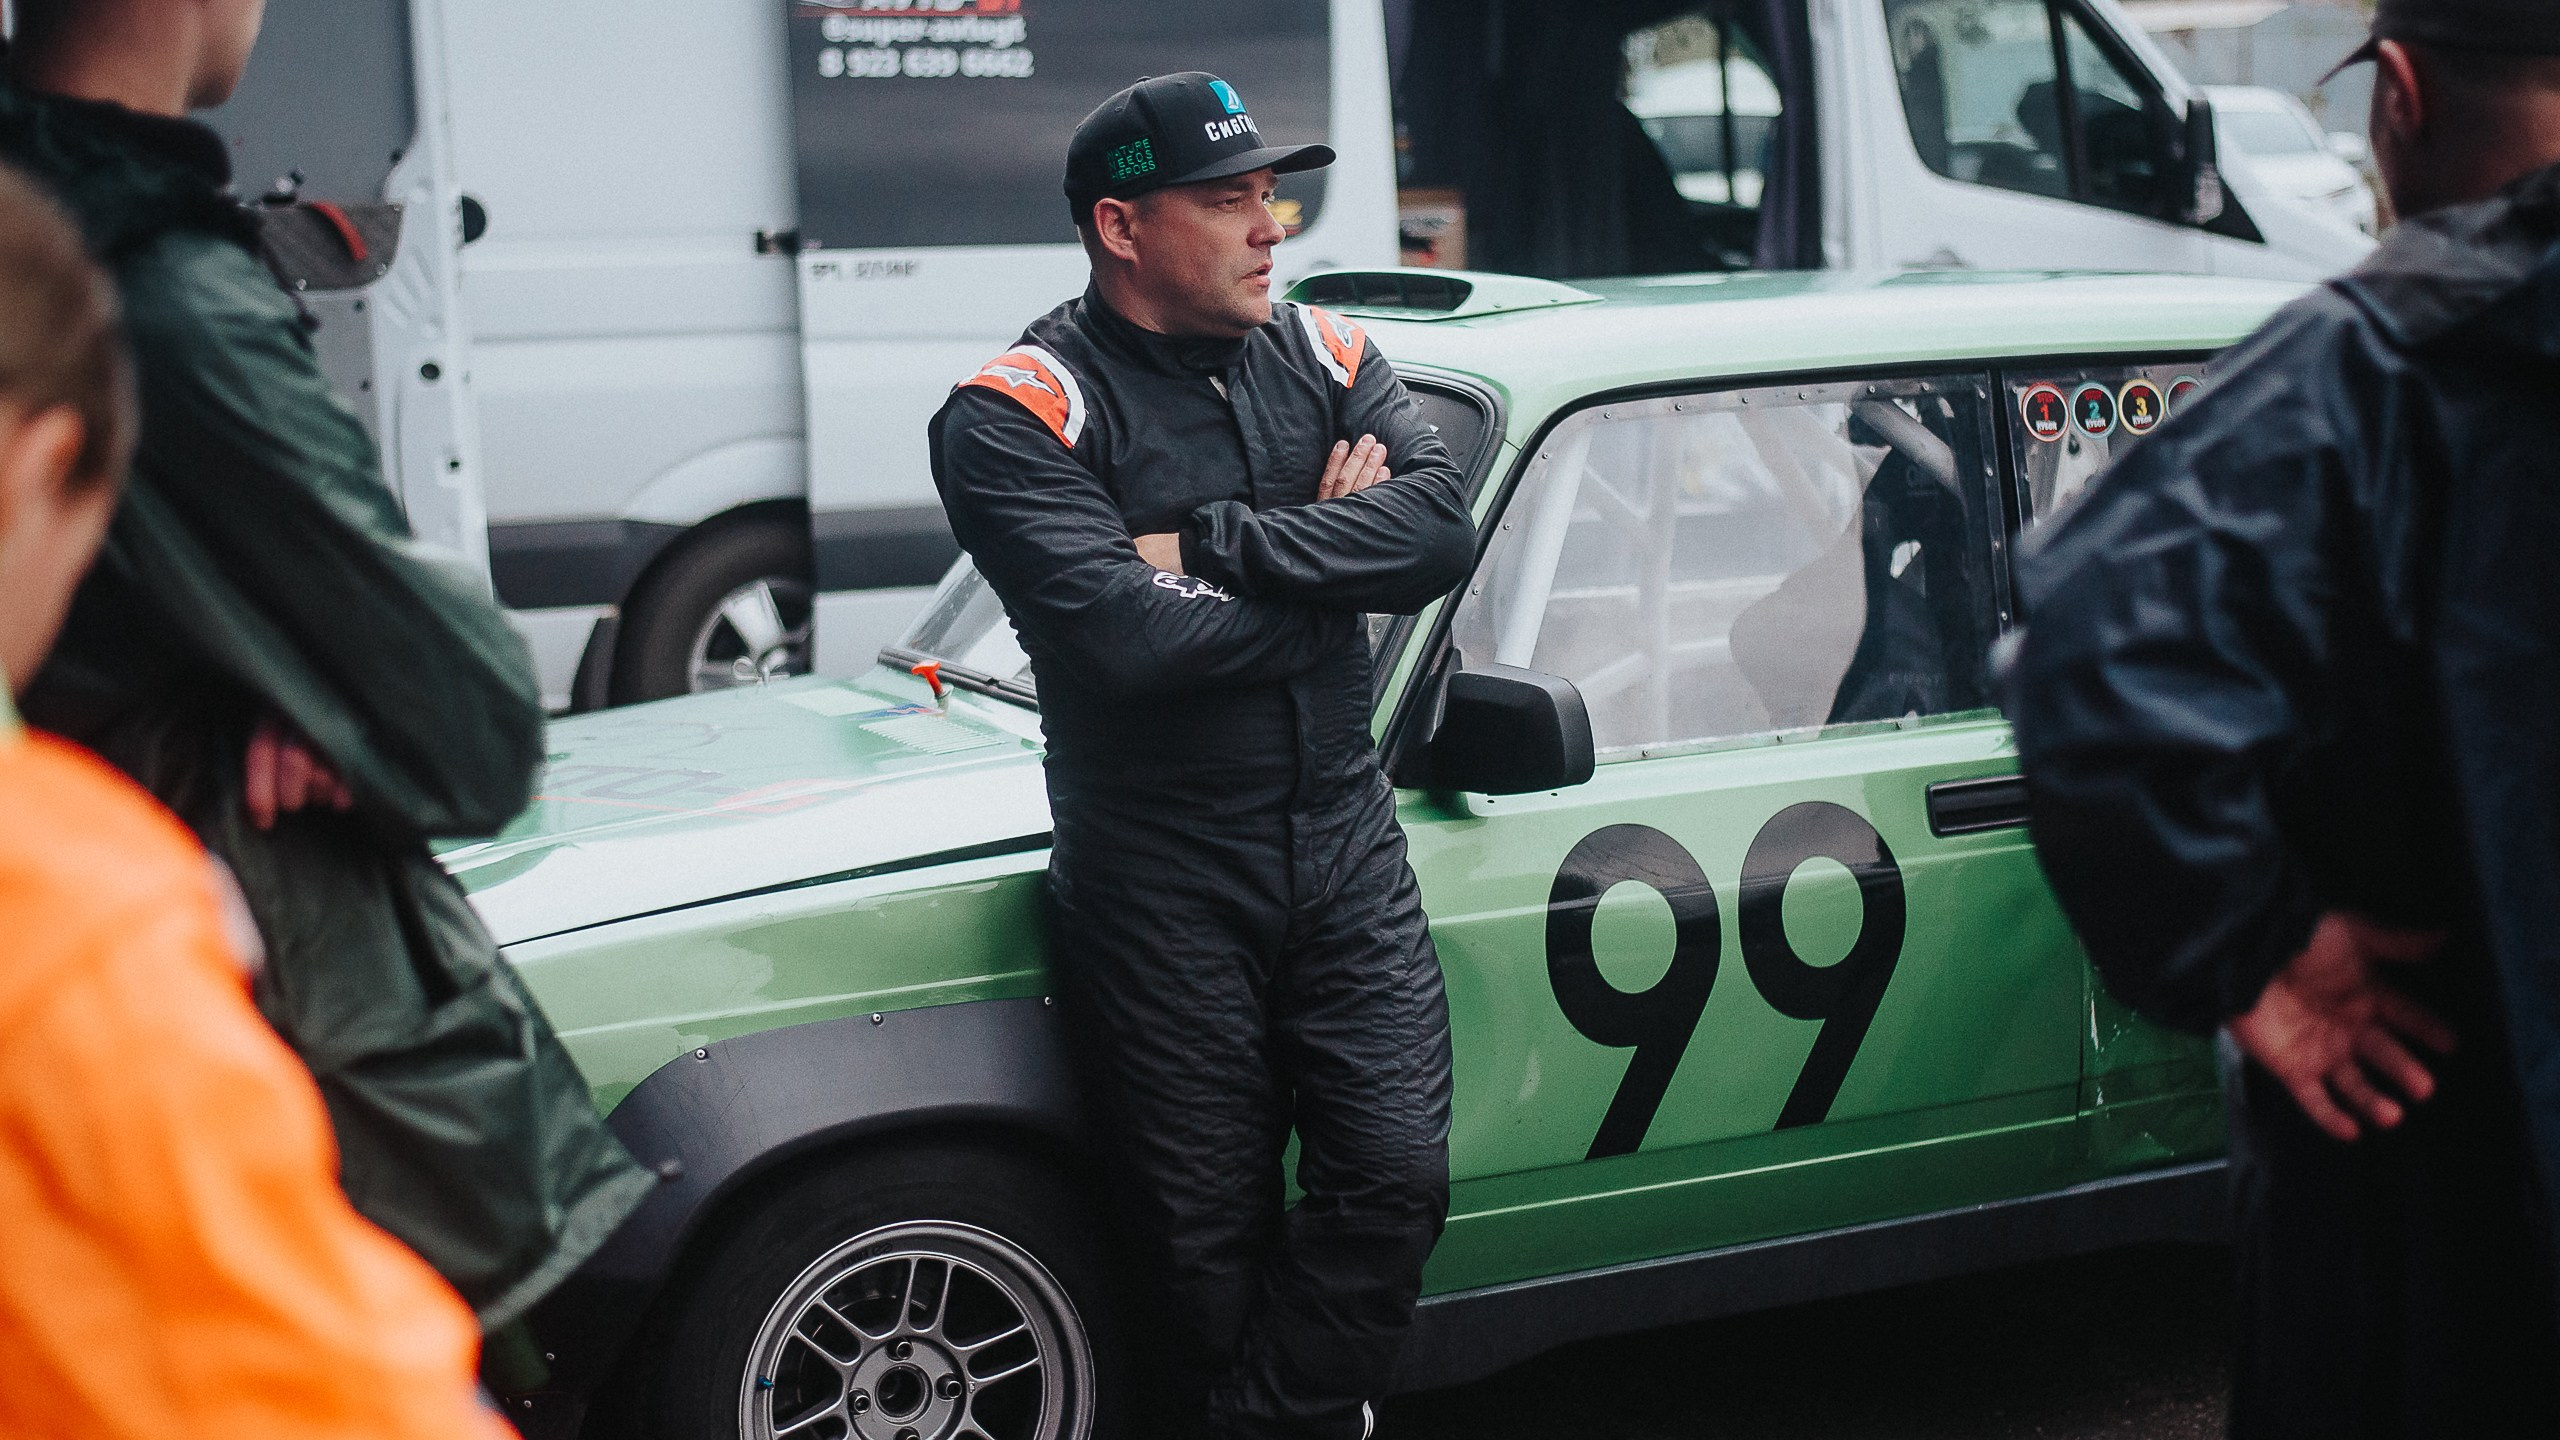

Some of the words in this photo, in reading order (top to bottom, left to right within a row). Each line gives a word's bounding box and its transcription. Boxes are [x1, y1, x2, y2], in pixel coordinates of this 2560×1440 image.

[818, 47, 844, 77] 8
[2040, 403, 2049, 421] 1
[2088, 401, 2100, 419] 2
[2135, 397, 2148, 416] 3
[1545, 801, 1906, 1160] 99
